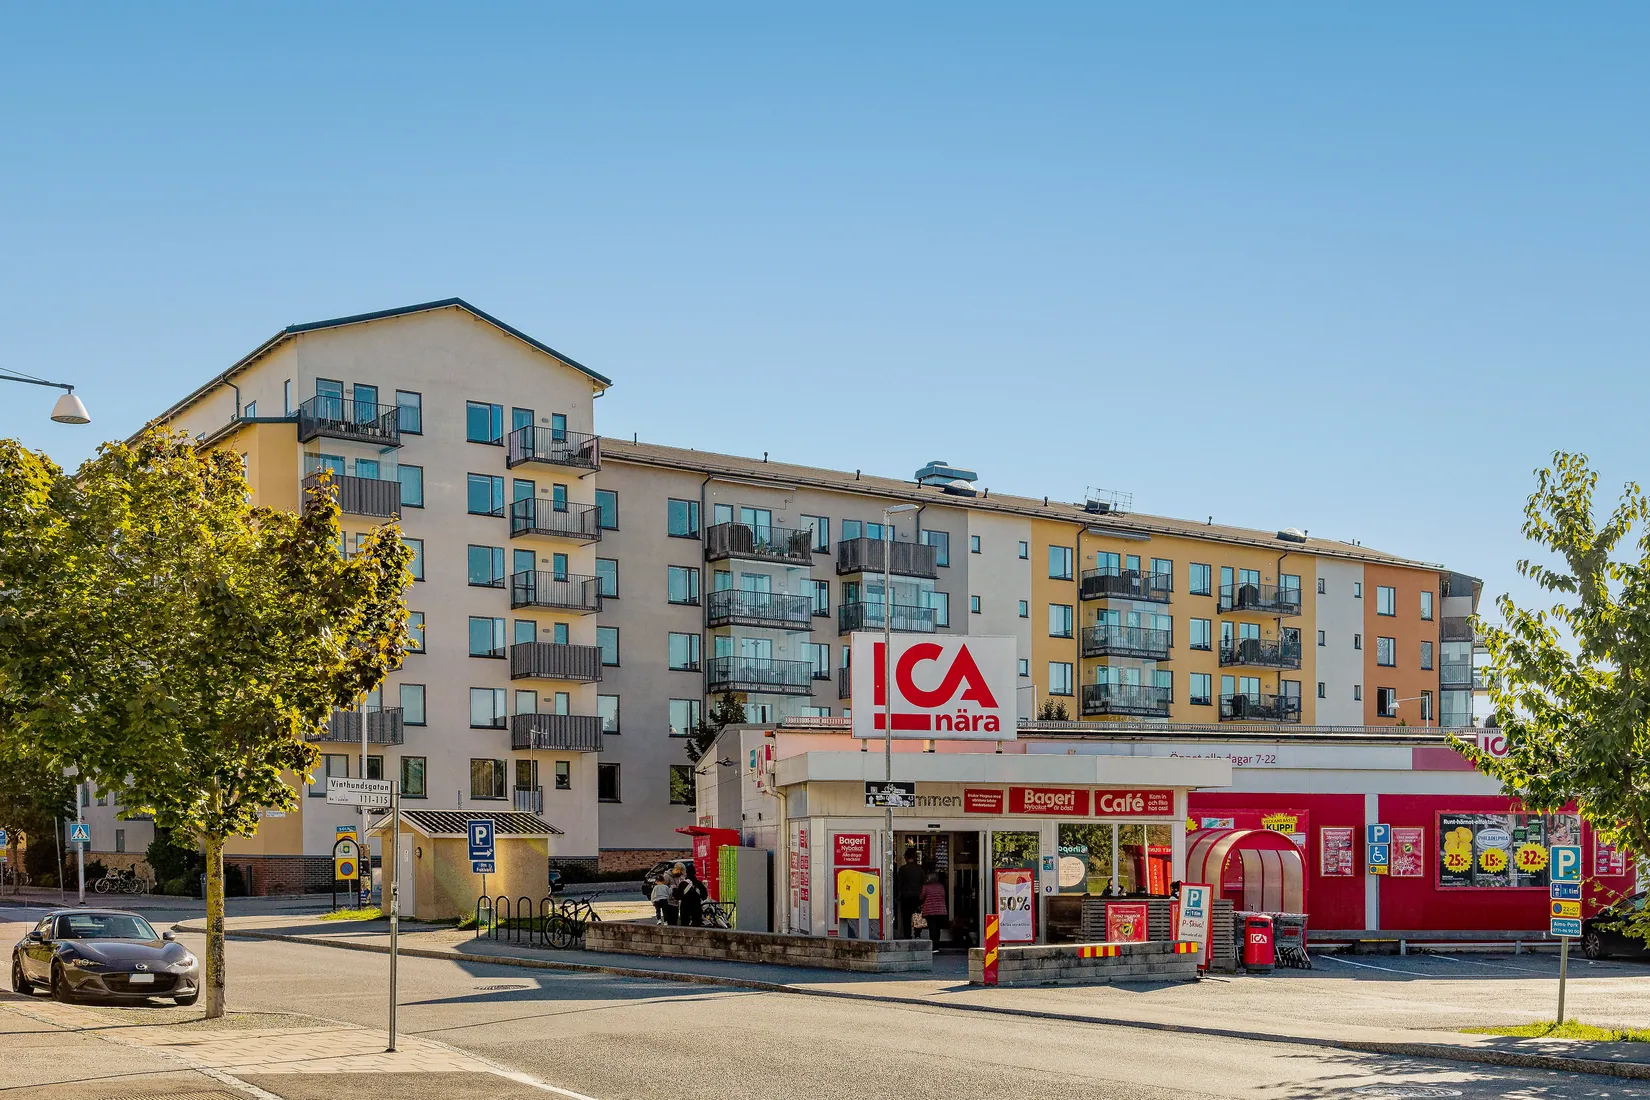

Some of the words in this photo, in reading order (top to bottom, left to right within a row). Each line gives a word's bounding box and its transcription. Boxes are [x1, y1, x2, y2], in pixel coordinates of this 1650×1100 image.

[874, 642, 999, 708] ICA
[936, 709, 1000, 732] nära
[1256, 754, 1276, 764] 7-22
[331, 780, 388, 791] Vinthundsgatan
[360, 795, 388, 804] 111-115
[1024, 789, 1074, 807] Bageri
[1100, 793, 1144, 812] Café
[475, 826, 487, 844] P
[1266, 824, 1293, 832] KLIPP!
[1374, 826, 1385, 842] P
[839, 836, 866, 846] Bageri
[1448, 854, 1467, 866] 25:-
[1485, 854, 1502, 866] 15:-
[1523, 850, 1545, 865] 32:-
[1558, 850, 1575, 877] P
[1000, 897, 1030, 911] 50%
[1190, 891, 1199, 906] P
